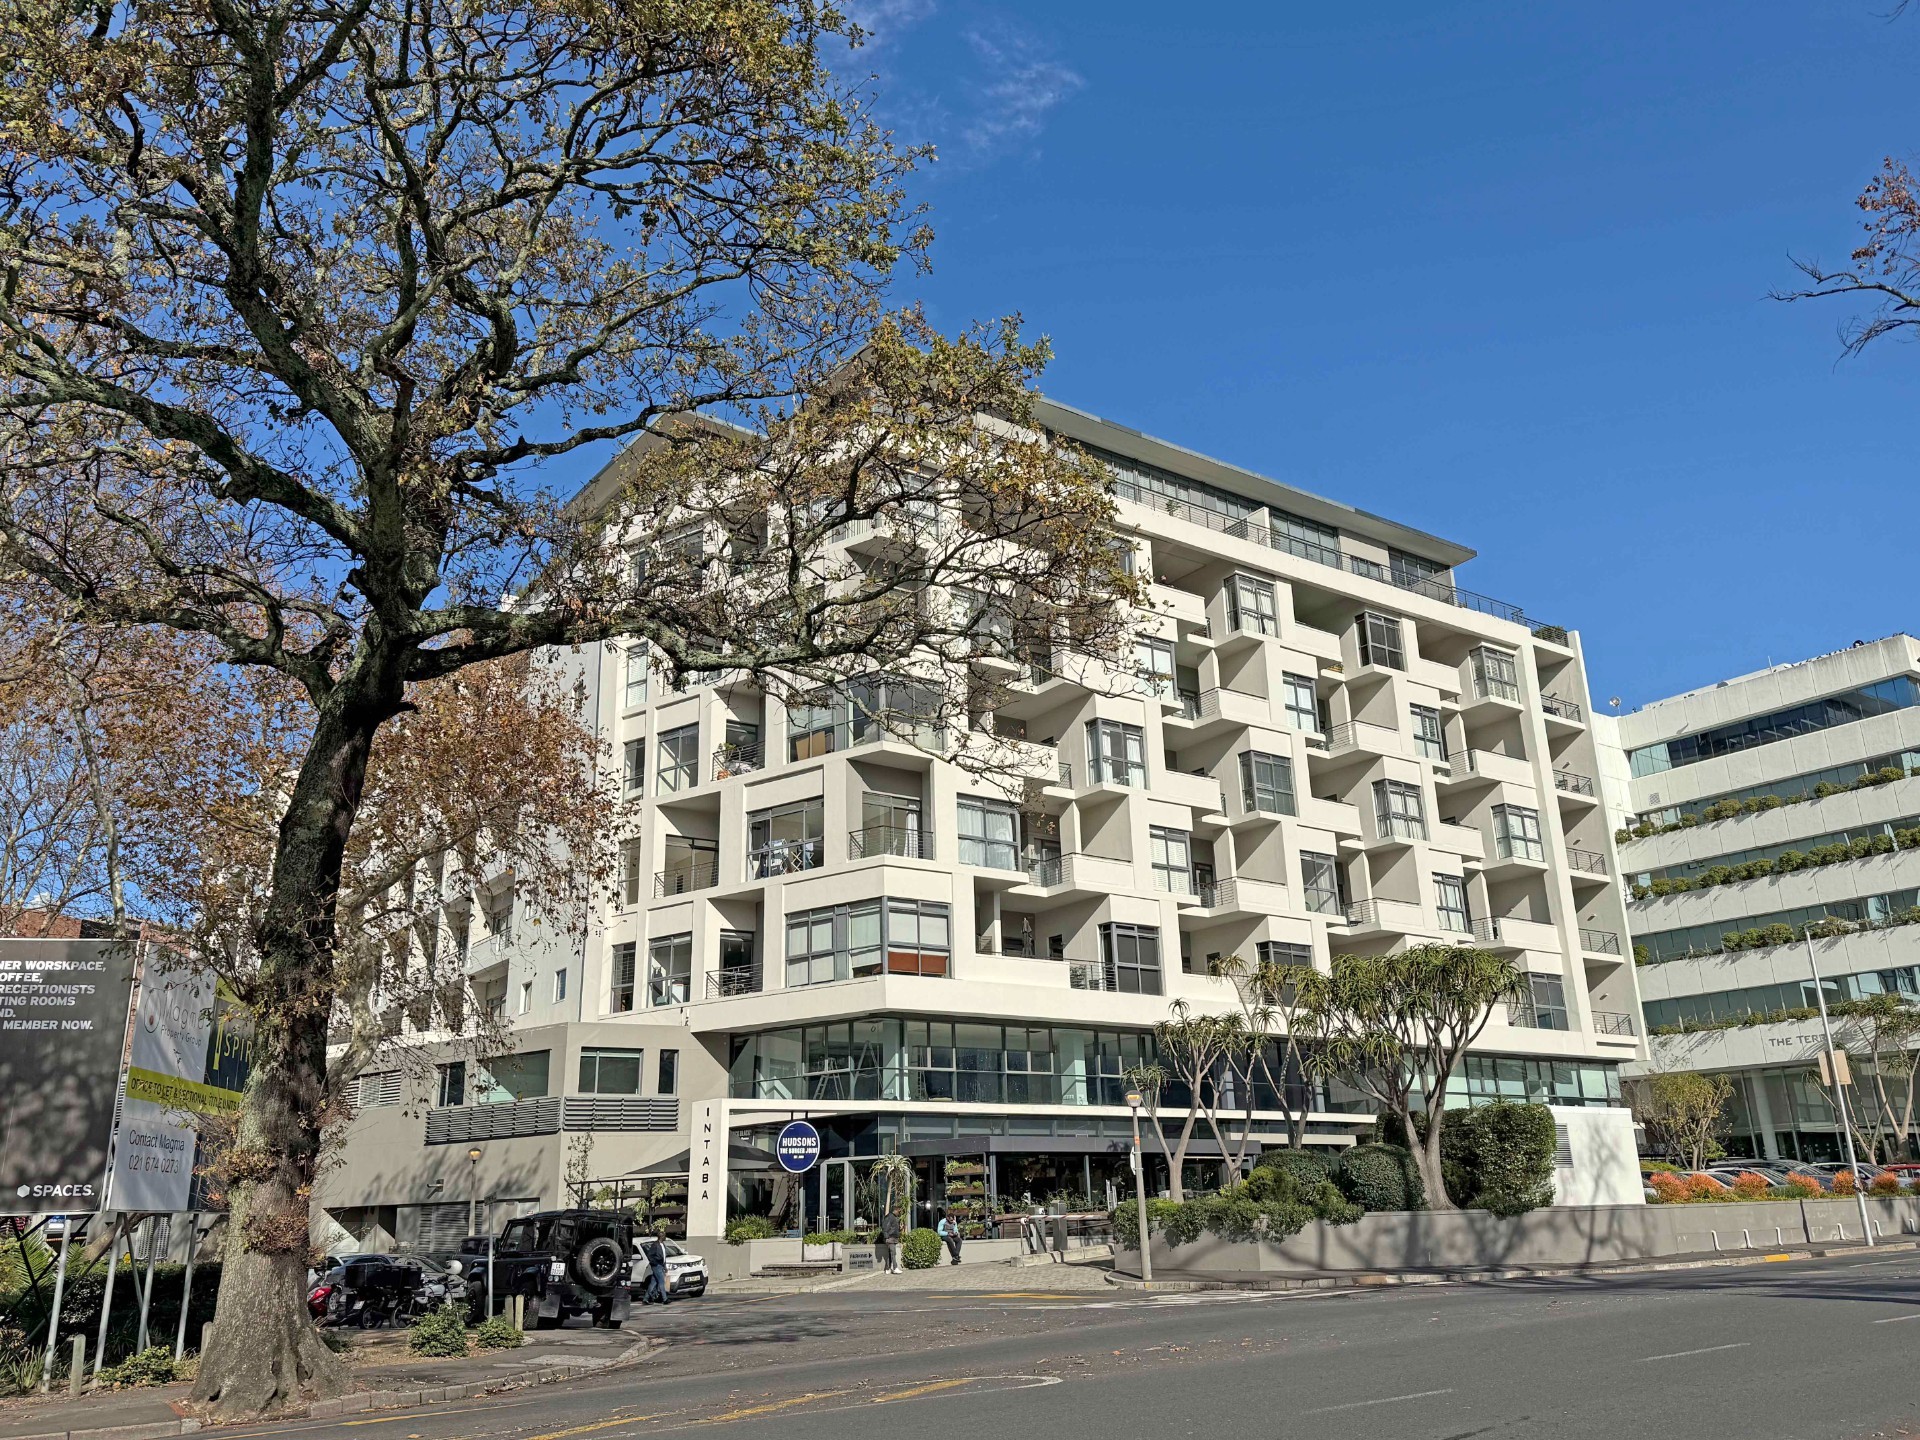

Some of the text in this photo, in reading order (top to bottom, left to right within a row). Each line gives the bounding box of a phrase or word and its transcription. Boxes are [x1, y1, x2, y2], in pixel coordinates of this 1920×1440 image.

[25, 960, 107, 973] WORSKPACE,
[0, 972, 43, 984] OFFEE,
[0, 984, 96, 995] RECEPTIONISTS
[30, 996, 76, 1006] ROOMS
[3, 1020, 94, 1030] MEMBER NOW.
[160, 1024, 202, 1048] Property Group
[1769, 1037, 1793, 1047] THE
[224, 1033, 253, 1063] SPIR
[129, 1129, 185, 1154] Contact Magma
[782, 1137, 817, 1147] HUDSONS
[702, 1107, 711, 1199] INTABA
[129, 1154, 180, 1174] 021 674 0273
[33, 1184, 95, 1197] SPACES.
